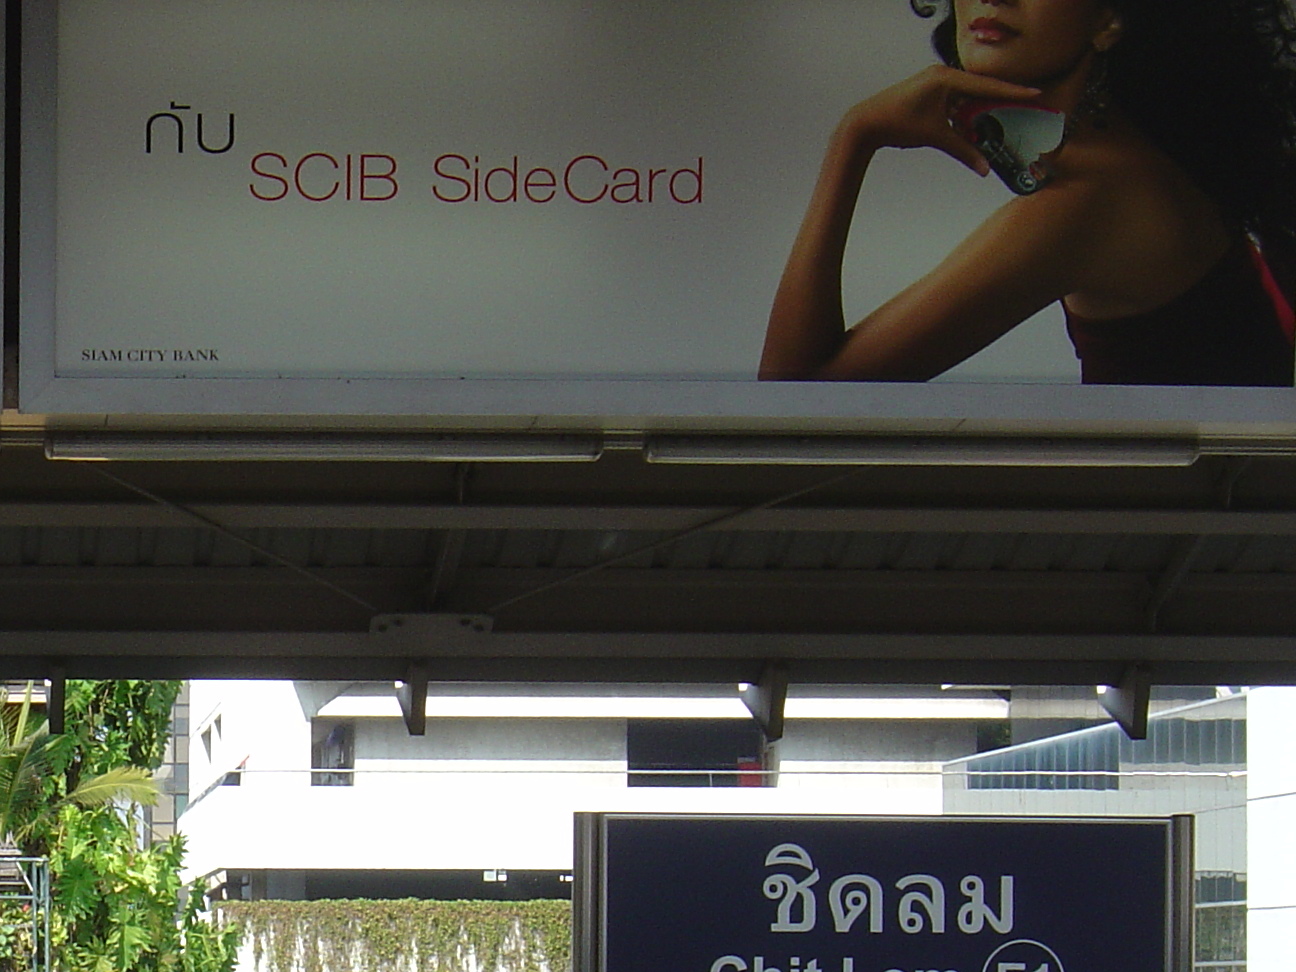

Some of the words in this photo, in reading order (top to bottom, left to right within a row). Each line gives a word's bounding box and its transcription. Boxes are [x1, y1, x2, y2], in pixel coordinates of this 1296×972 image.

[145, 101, 235, 154] กับ
[249, 152, 400, 202] SCIB
[431, 153, 704, 204] SideCard
[82, 349, 123, 361] SIAM
[127, 349, 168, 362] CITY
[173, 349, 219, 362] BANK
[762, 843, 1015, 935] ชิดลม
